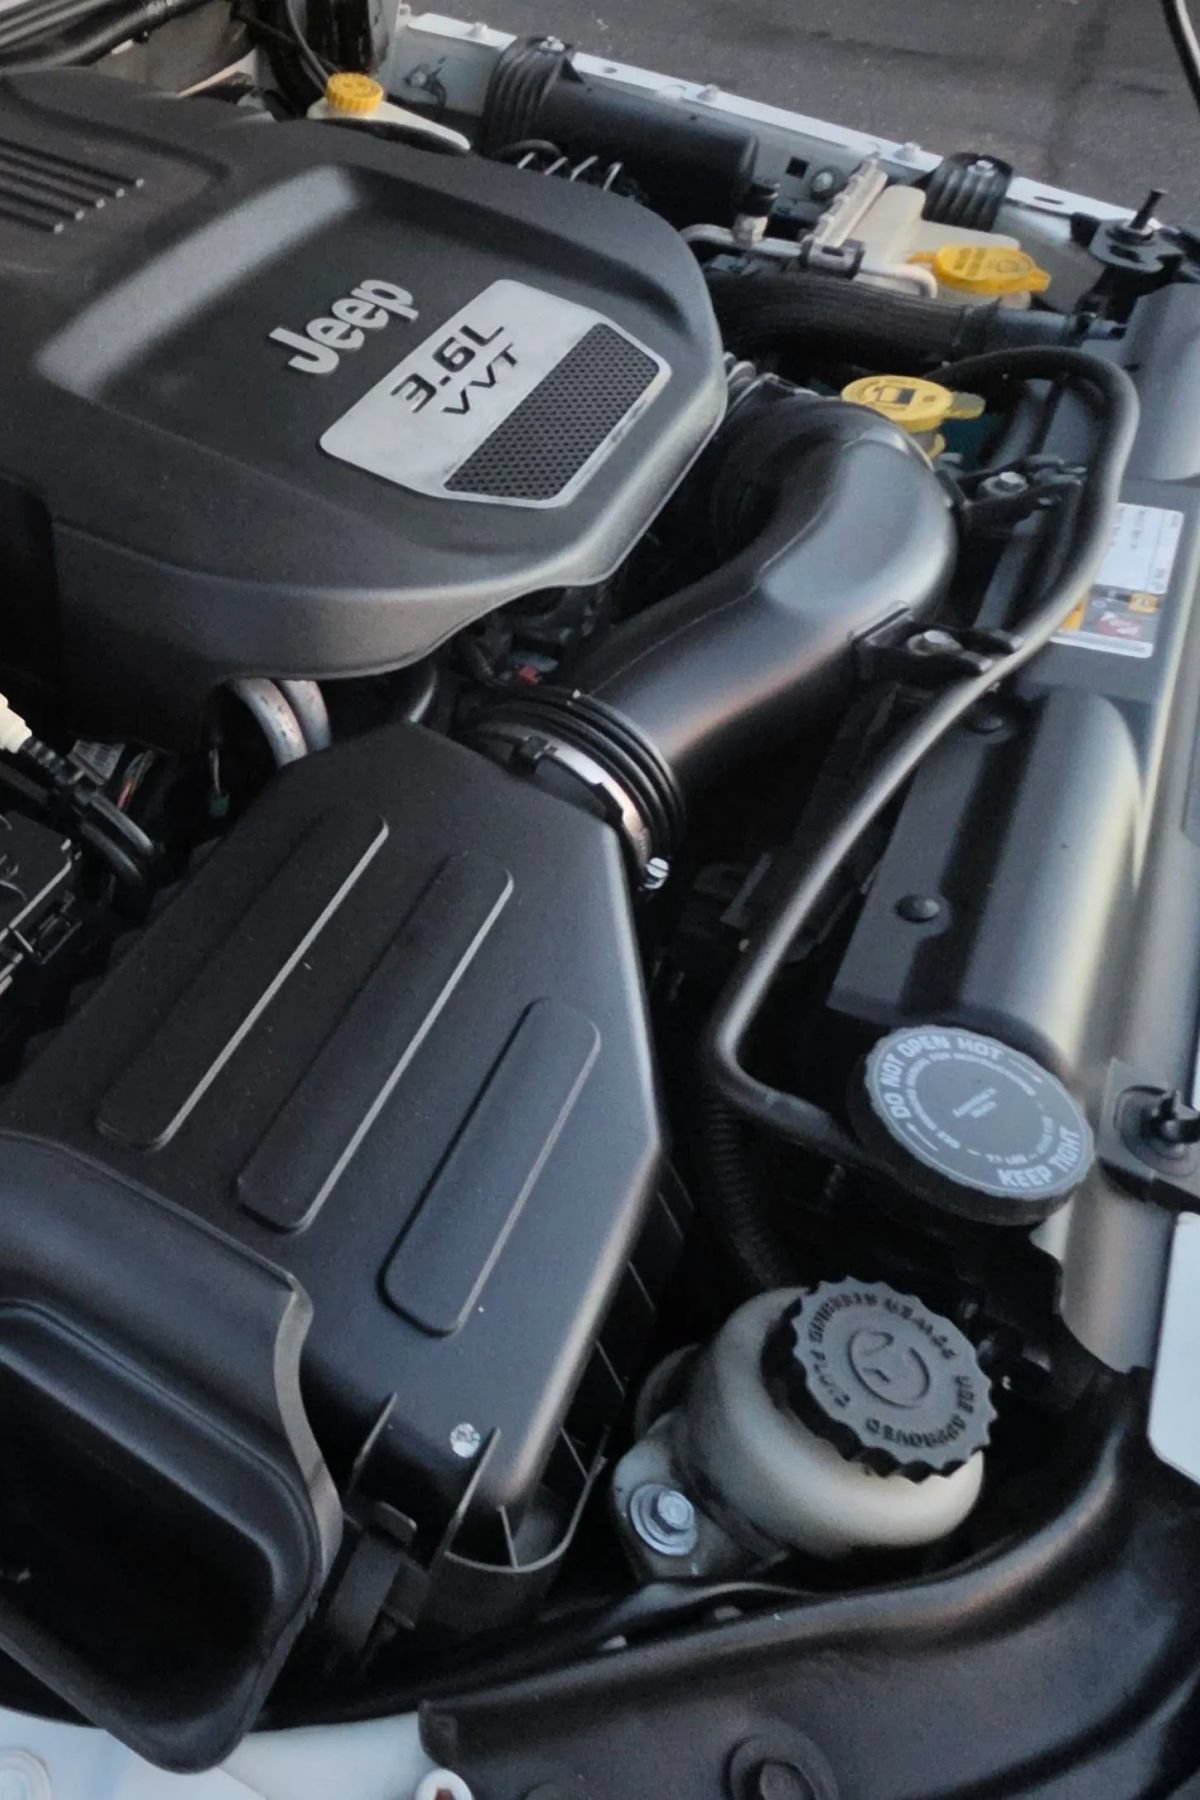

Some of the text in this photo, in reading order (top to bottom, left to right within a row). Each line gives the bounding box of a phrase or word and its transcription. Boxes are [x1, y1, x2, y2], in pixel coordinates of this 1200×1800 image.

[268, 278, 420, 375] Jeep
[390, 321, 505, 415] 3.6L
[442, 342, 519, 416] VVT
[880, 1034, 1005, 1120] DO NOT OPEN HOT
[996, 1124, 1082, 1188] KEEP TIGHT
